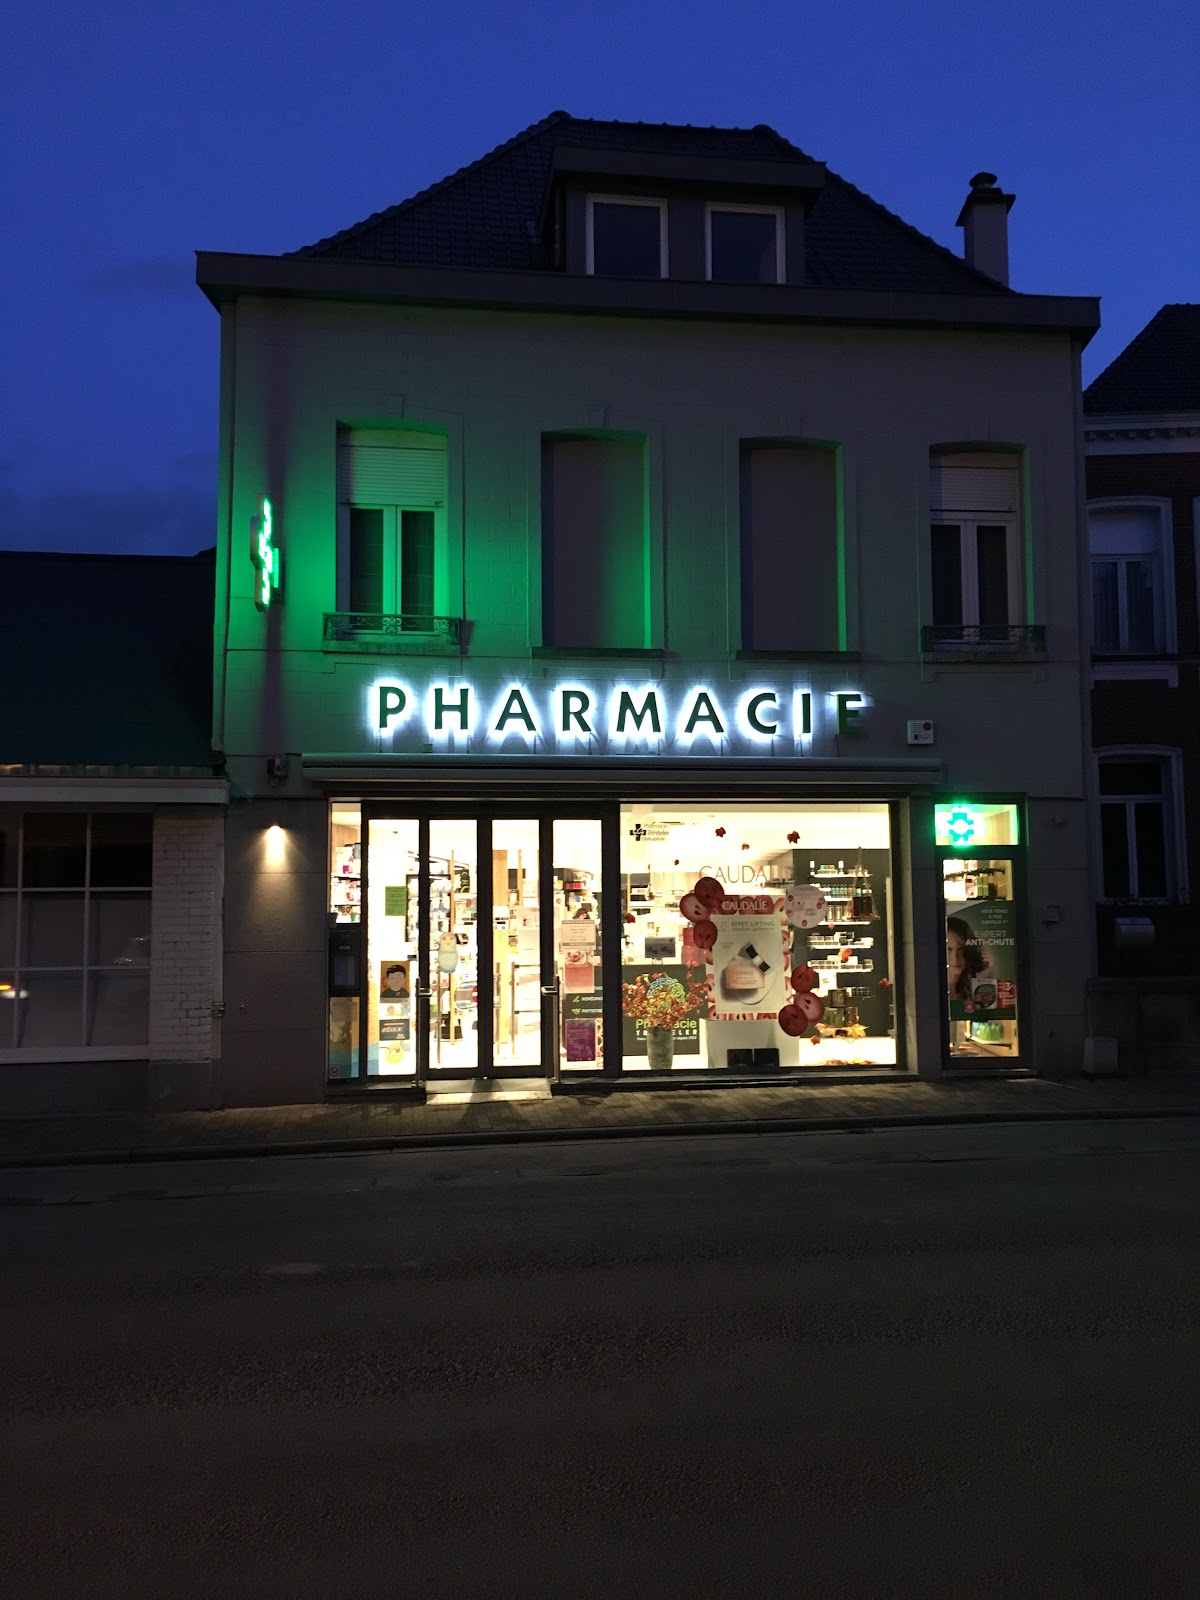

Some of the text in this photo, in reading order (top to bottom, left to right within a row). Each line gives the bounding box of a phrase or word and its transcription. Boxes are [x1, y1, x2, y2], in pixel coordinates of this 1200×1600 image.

[379, 685, 862, 735] PHARMACIE
[974, 930, 1007, 938] EXPERT
[965, 938, 1015, 946] ANTI-CHUTE
